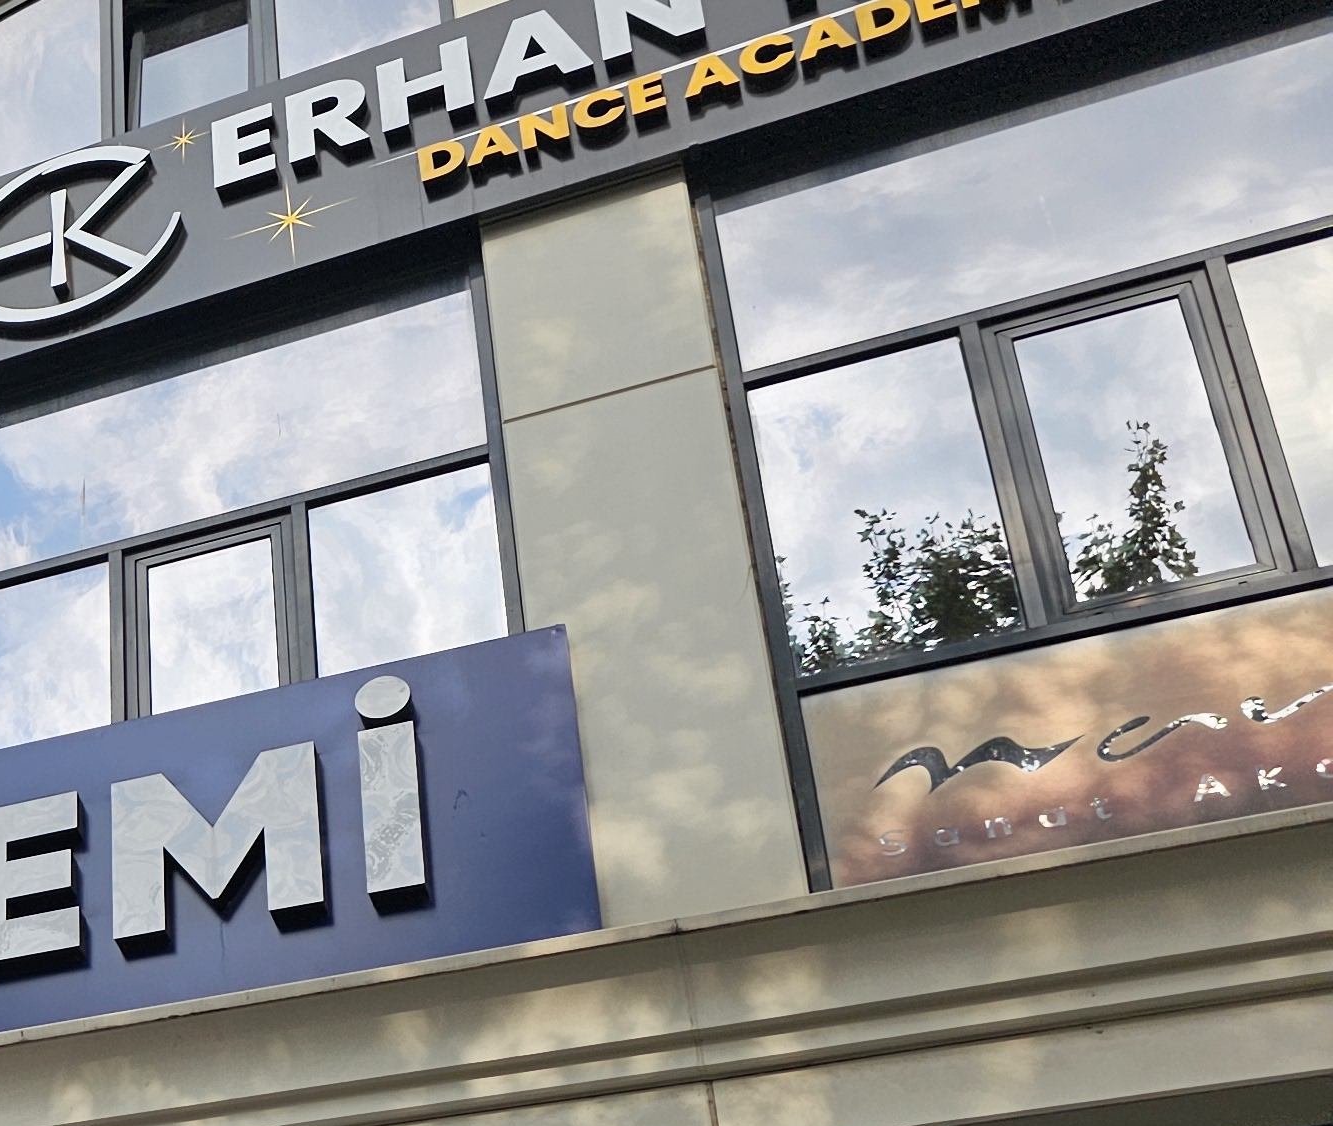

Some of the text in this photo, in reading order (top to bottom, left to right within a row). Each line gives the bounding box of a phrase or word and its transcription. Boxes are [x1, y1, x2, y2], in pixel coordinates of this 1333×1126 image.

[211, 0, 708, 196] ERHAN
[417, 0, 982, 184] DANCE ACADE
